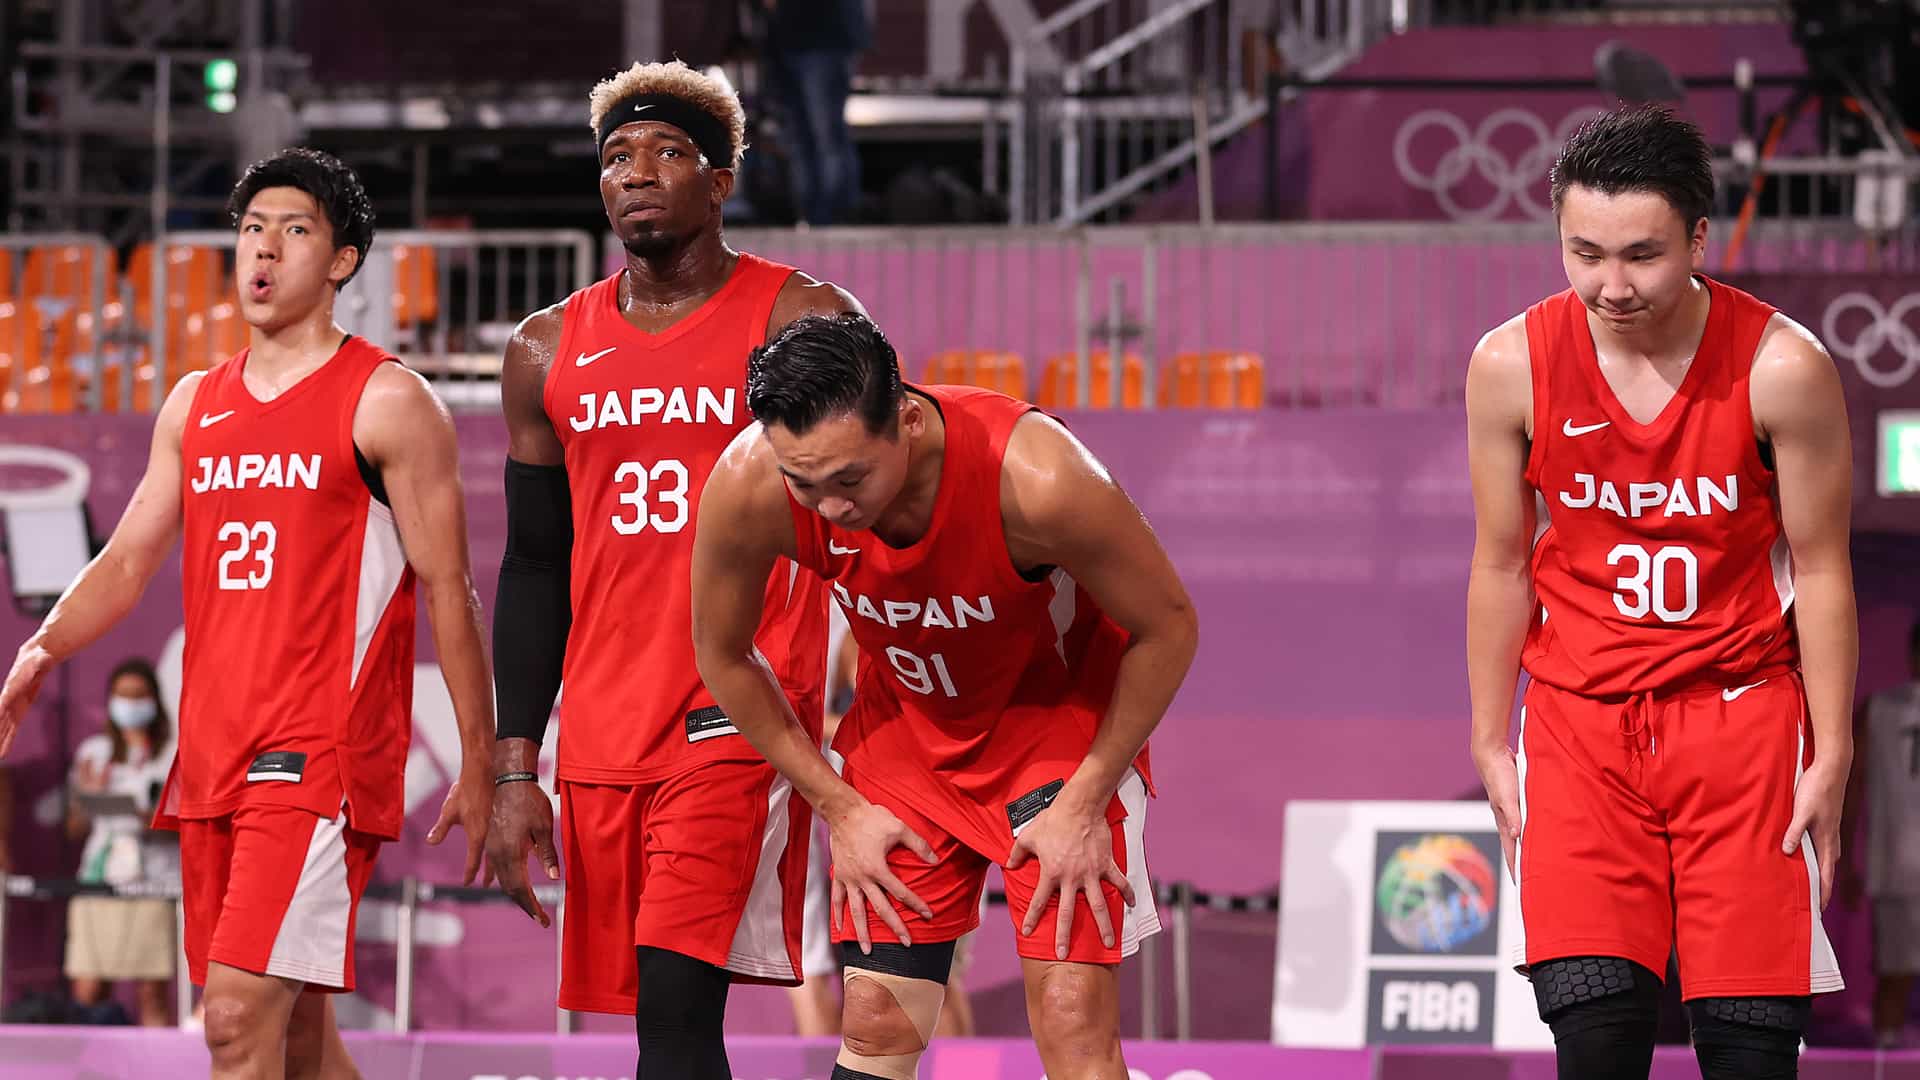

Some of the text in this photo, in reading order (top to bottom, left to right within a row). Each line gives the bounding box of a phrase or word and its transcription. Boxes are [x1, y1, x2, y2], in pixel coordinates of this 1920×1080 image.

[569, 387, 736, 432] JAPAN
[192, 453, 322, 494] JAPAN
[611, 459, 689, 535] 33
[1559, 472, 1739, 518] JAPAN
[218, 521, 277, 590] 23
[833, 580, 996, 628] JAPAN
[1606, 543, 1698, 623] 30
[886, 646, 959, 697] 91
[1382, 980, 1480, 1032] FIBA
